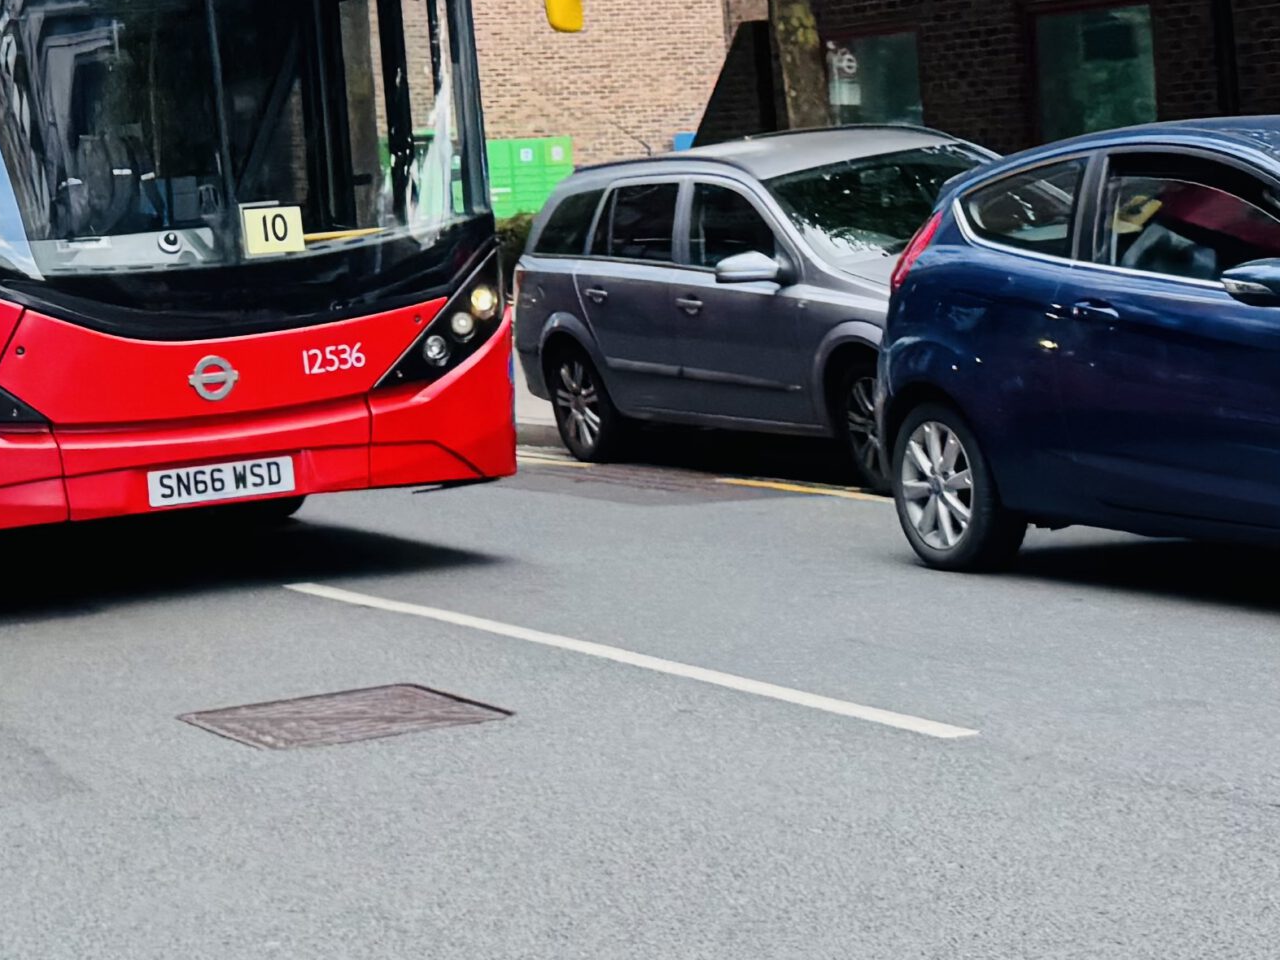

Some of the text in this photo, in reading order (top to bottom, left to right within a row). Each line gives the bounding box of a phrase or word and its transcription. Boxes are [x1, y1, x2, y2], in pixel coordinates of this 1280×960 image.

[261, 213, 289, 243] 10
[302, 342, 367, 375] 12536
[158, 461, 283, 499] SN66 WSD
